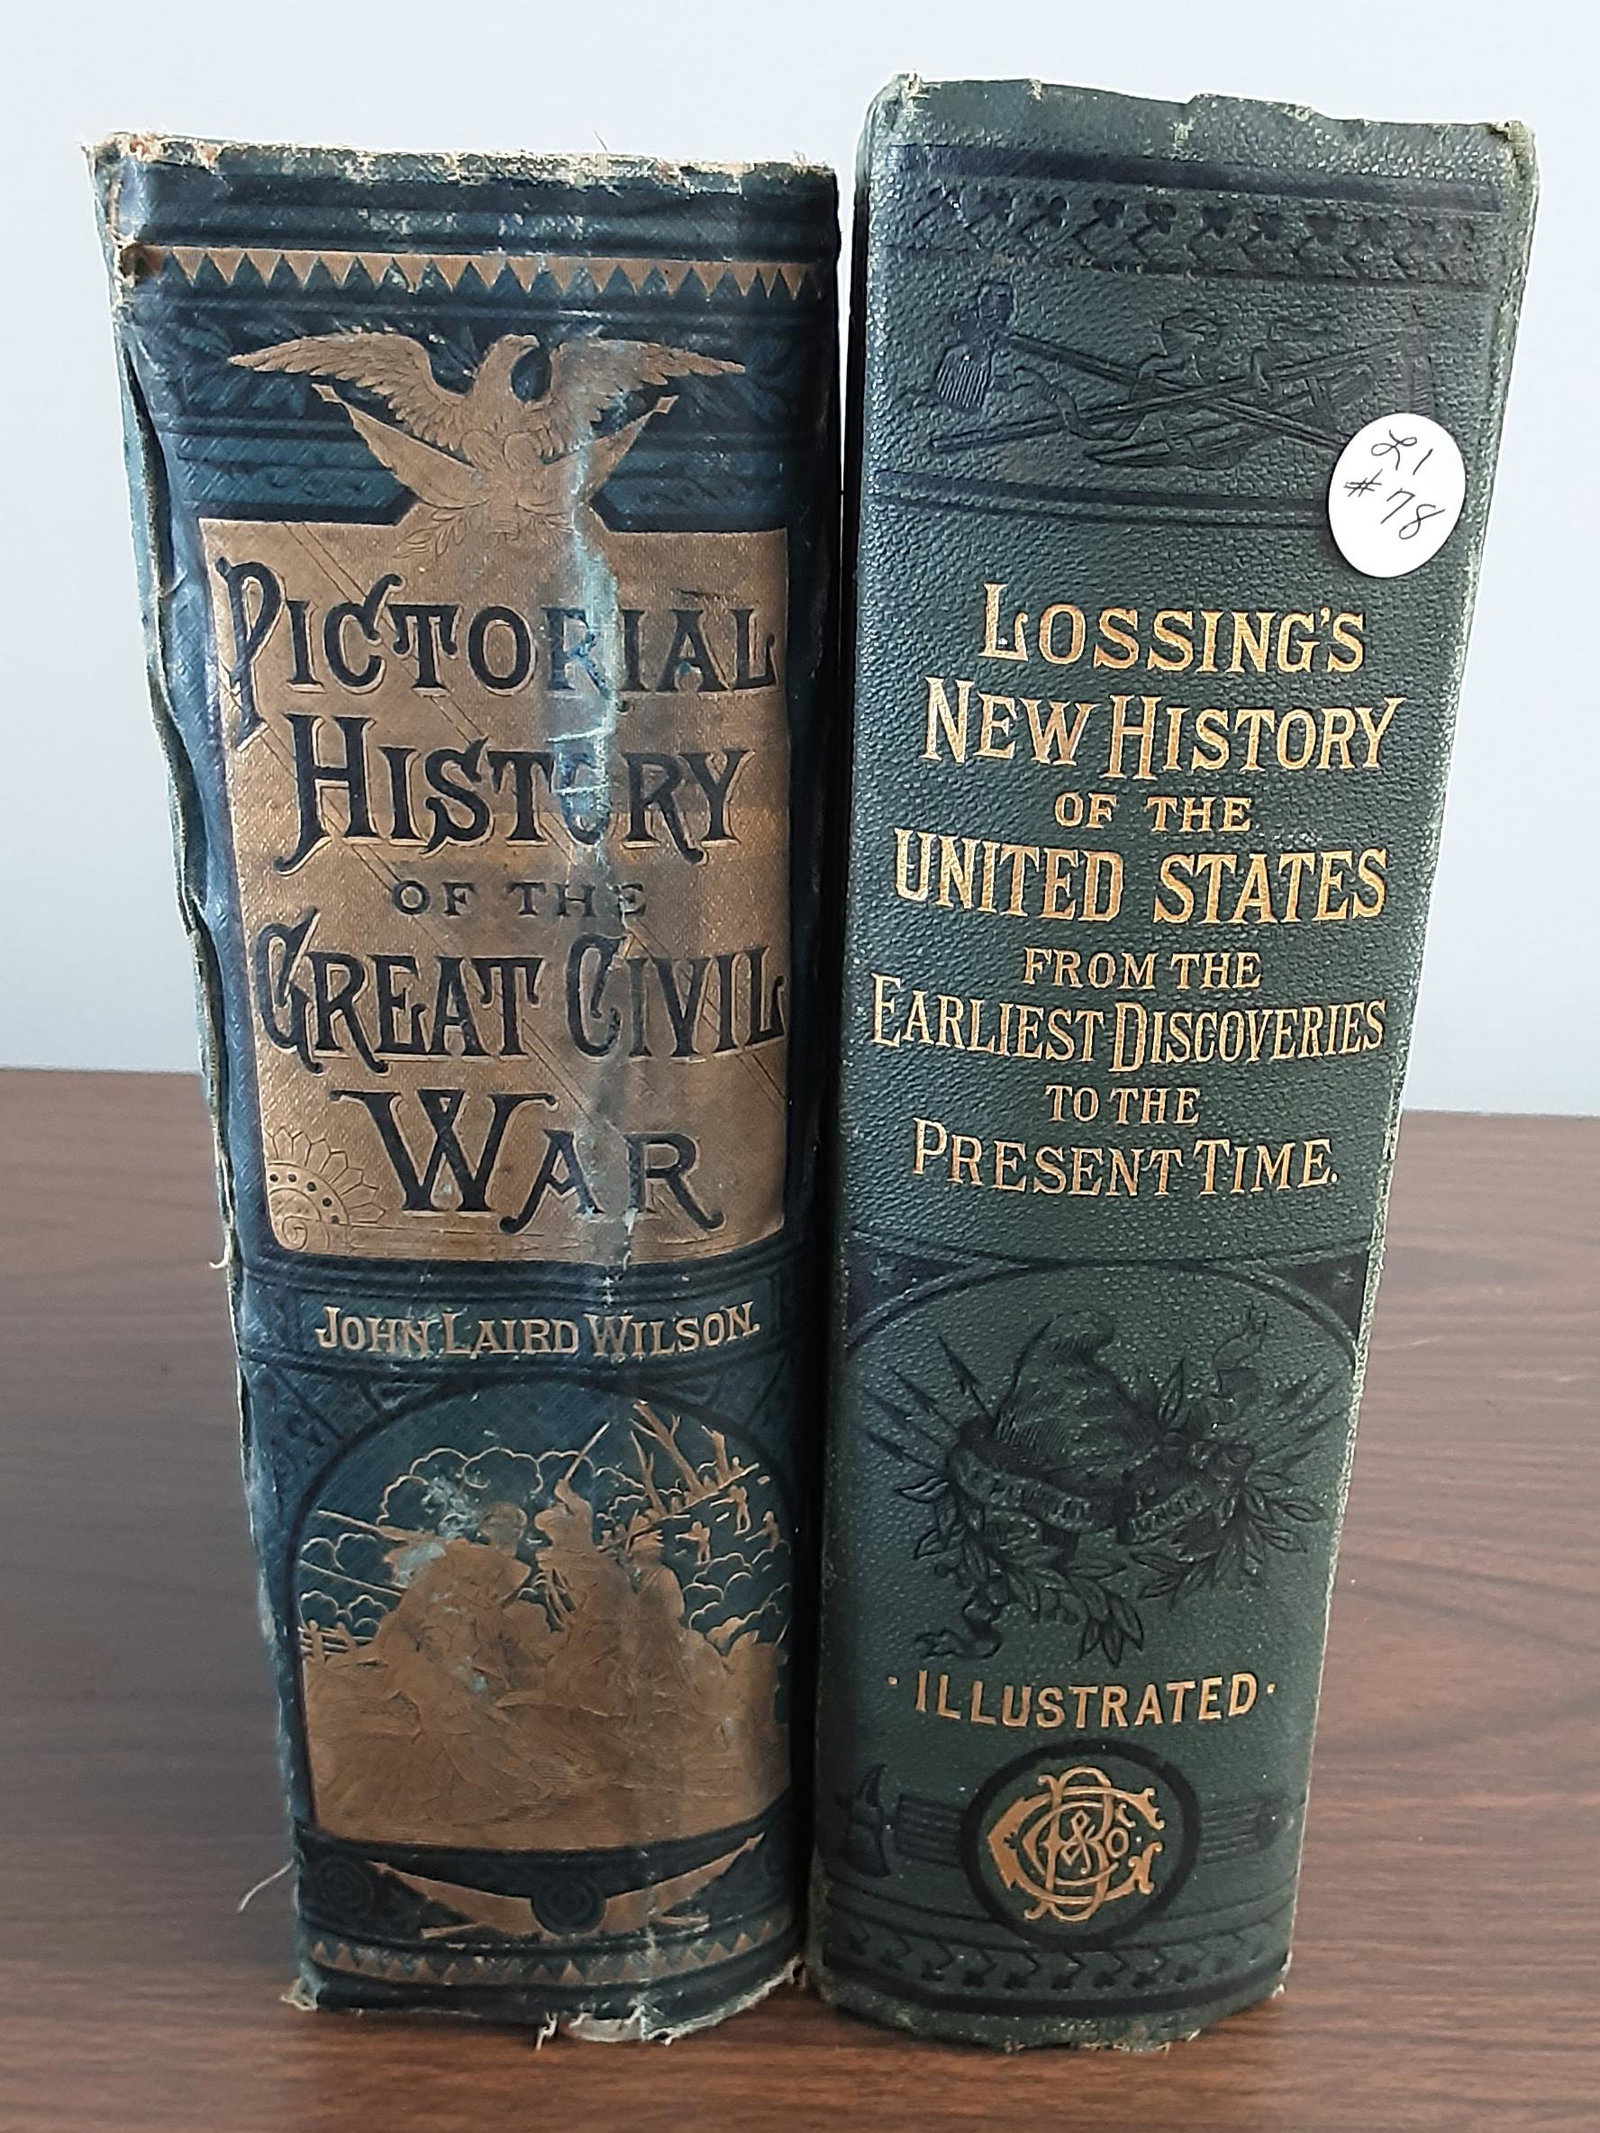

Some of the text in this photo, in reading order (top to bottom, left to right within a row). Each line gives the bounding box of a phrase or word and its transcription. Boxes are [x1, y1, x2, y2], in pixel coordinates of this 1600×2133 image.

[216, 557, 778, 748] PICTORIAL
[978, 583, 1364, 673] LOSSING'S
[920, 677, 1405, 780] NEW HISTORY
[274, 713, 755, 875] HISTORY
[1053, 792, 1253, 832] OF THE
[393, 880, 648, 917] OF THE
[893, 827, 1388, 925] UNITED STATES
[255, 907, 785, 1074] GREAT CIVIL
[1022, 948, 1262, 990] FROM THE
[869, 973, 1388, 1073] EARLIEST DISCOVERIES
[1044, 1084, 1201, 1126] TO THE
[330, 1089, 726, 1234] WAR
[912, 1117, 1339, 1197] PRESENT TIME.
[314, 1301, 760, 1359] JOHN LAIRD WILSON.
